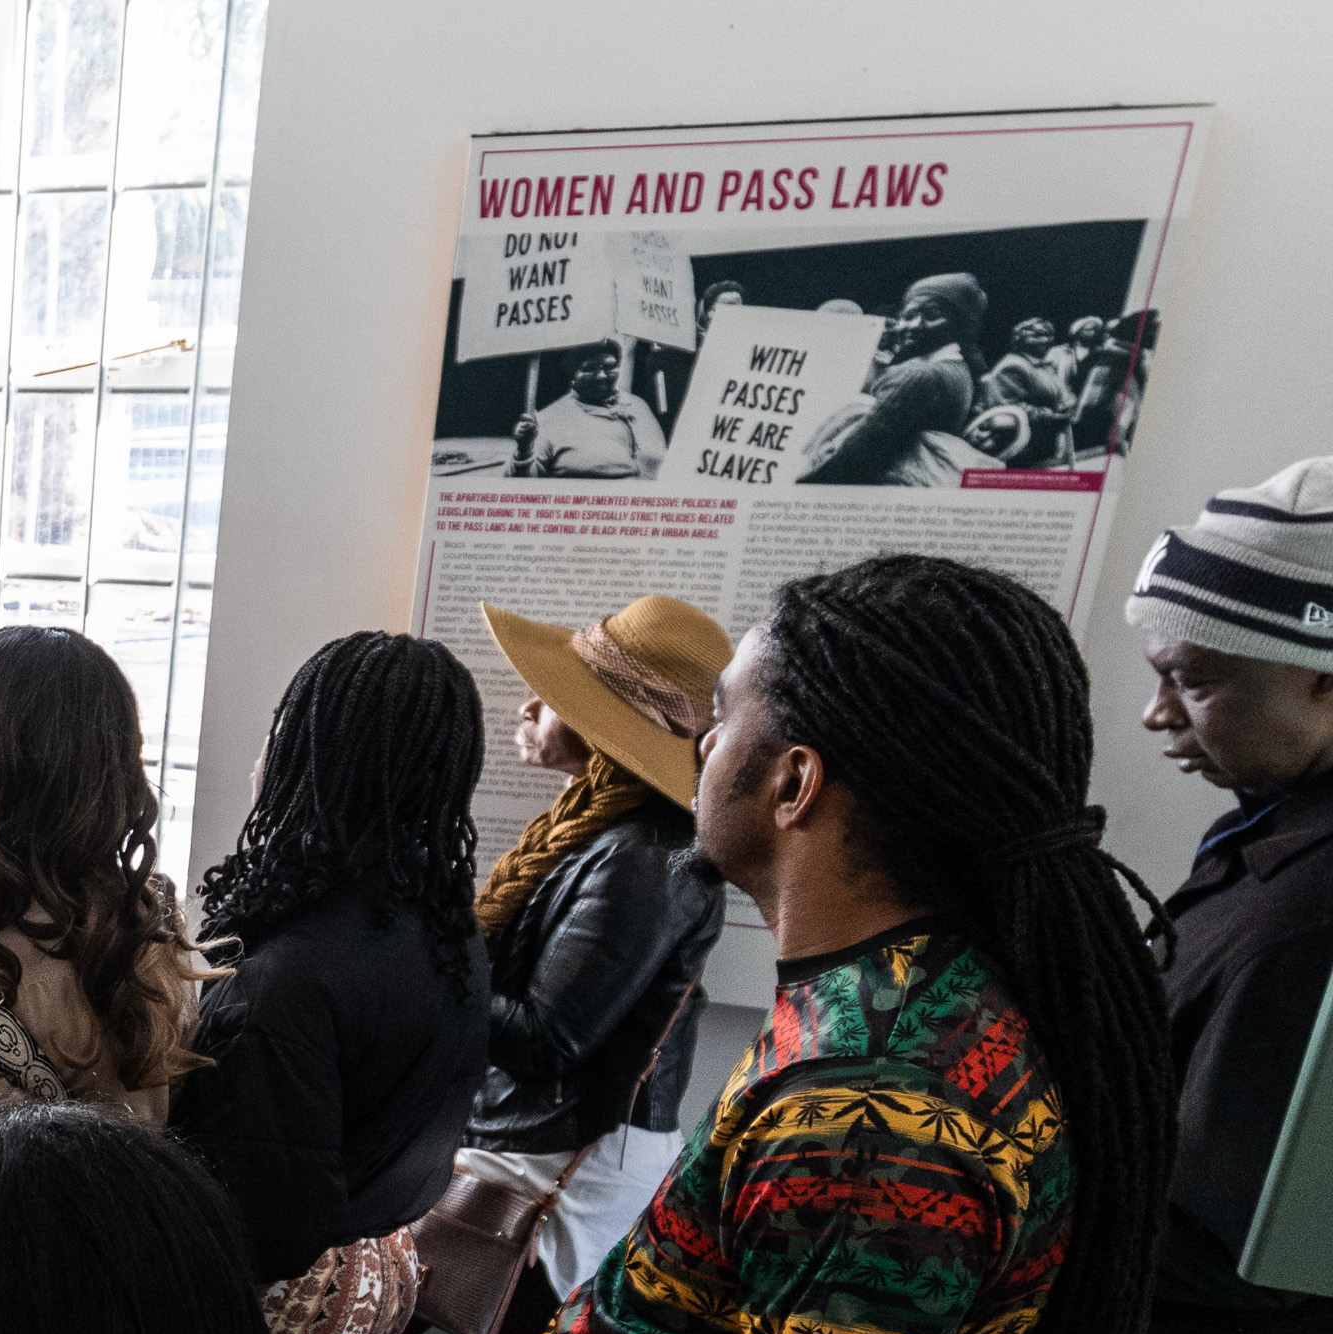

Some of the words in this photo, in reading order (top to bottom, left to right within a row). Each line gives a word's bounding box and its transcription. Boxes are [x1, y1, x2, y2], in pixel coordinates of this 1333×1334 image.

[479, 174, 615, 218] WOMEN
[625, 170, 705, 214] AND
[718, 166, 819, 212] PASS
[832, 162, 949, 208] LAWS
[504, 232, 532, 258] DO
[509, 258, 571, 291] WANT
[496, 294, 573, 328] PASSES
[748, 344, 808, 376] WITH
[720, 378, 806, 416] PASSES
[711, 414, 744, 444] WE
[748, 420, 793, 451] ARE
[696, 448, 778, 484] SLAVES
[437, 506, 484, 517] LEGISLATION
[486, 508, 515, 518] DURING
[517, 508, 531, 518] THE
[562, 510, 579, 520] AND
[581, 510, 628, 521] ESPECIALLY
[629, 512, 658, 522] STRICT
[660, 512, 696, 523] POLICIES
[697, 514, 734, 524] RELATED
[439, 492, 454, 502] THE
[455, 492, 498, 503] APARTHEID
[499, 494, 552, 504] GOVERNMENT
[554, 495, 570, 505] HAD
[572, 496, 628, 506] IMPLEMENTED
[630, 497, 680, 508] REPRESSIVE
[680, 499, 717, 509] POLICIES
[719, 500, 738, 510] AND
[436, 520, 446, 530] TO
[447, 521, 460, 530] THE
[463, 521, 483, 531] PASS
[484, 522, 506, 532] LAWS
[507, 522, 524, 532] AND
[526, 523, 541, 533] THE
[542, 524, 577, 534] CONTROL
[579, 525, 590, 534] OF
[590, 525, 617, 535] BLACK
[618, 526, 648, 536] PEOPLE
[650, 527, 660, 536] IN
[661, 527, 688, 537] URBAN
